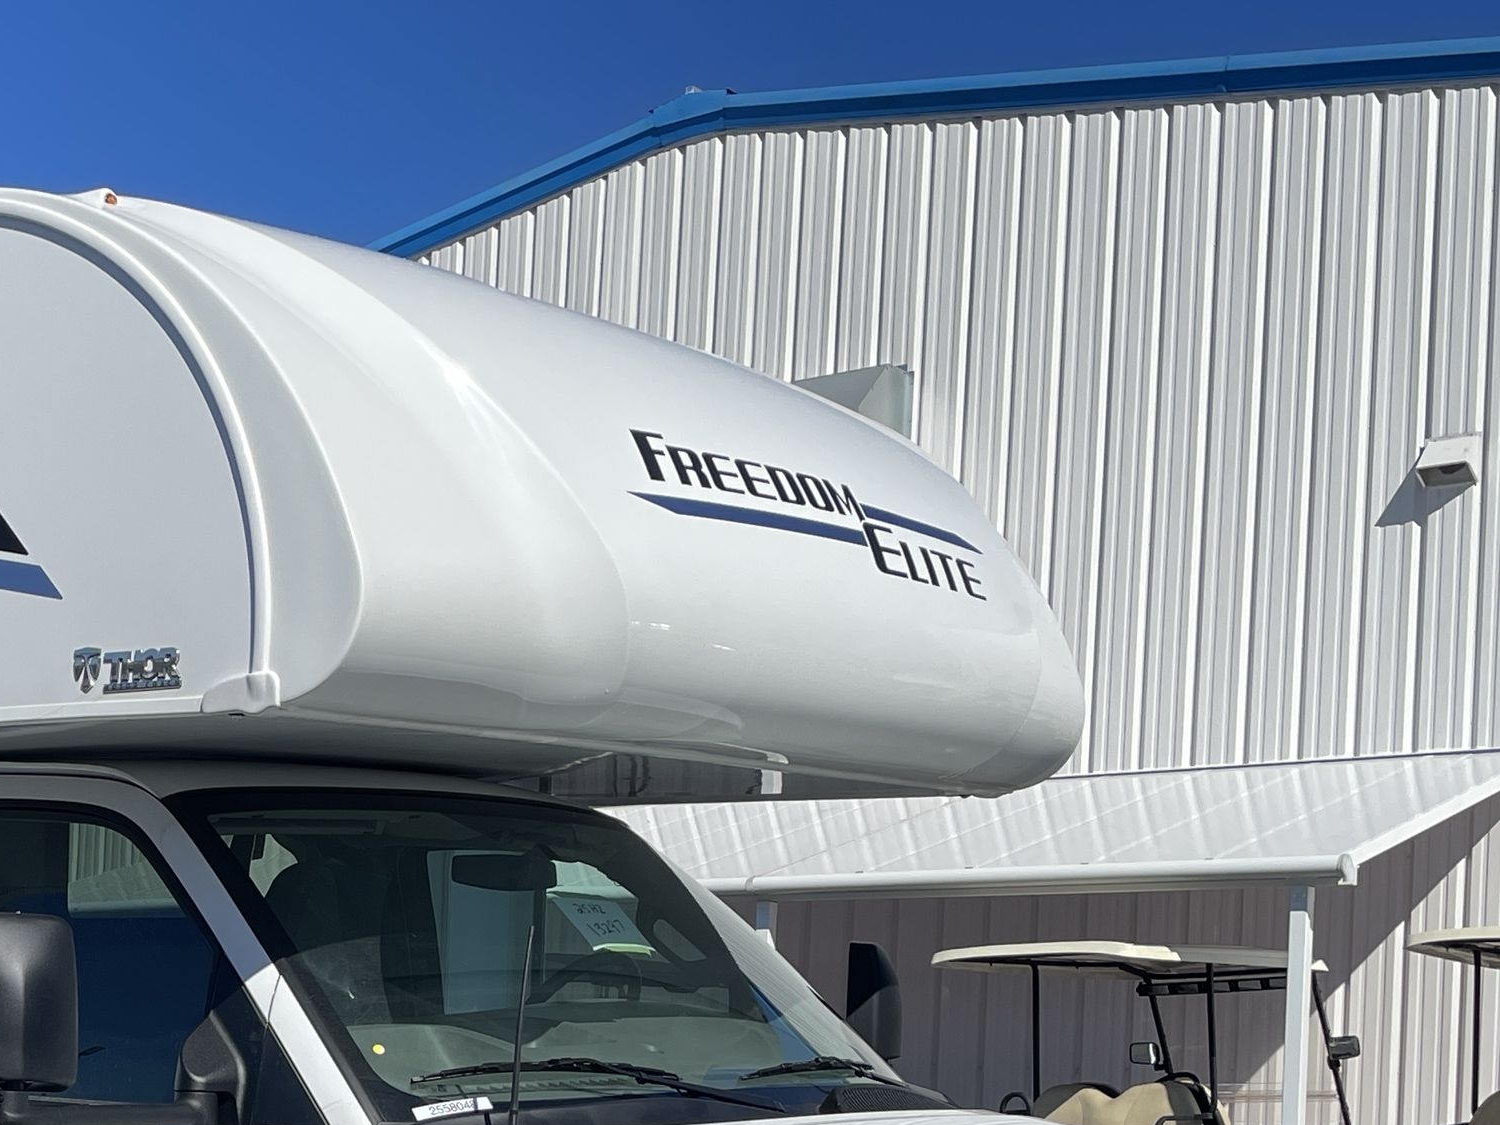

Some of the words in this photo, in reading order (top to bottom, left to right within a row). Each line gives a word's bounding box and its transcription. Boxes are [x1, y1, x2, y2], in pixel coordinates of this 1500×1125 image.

[629, 428, 866, 521] FREEDOM
[862, 522, 987, 601] ELITE
[103, 647, 181, 683] THOR
